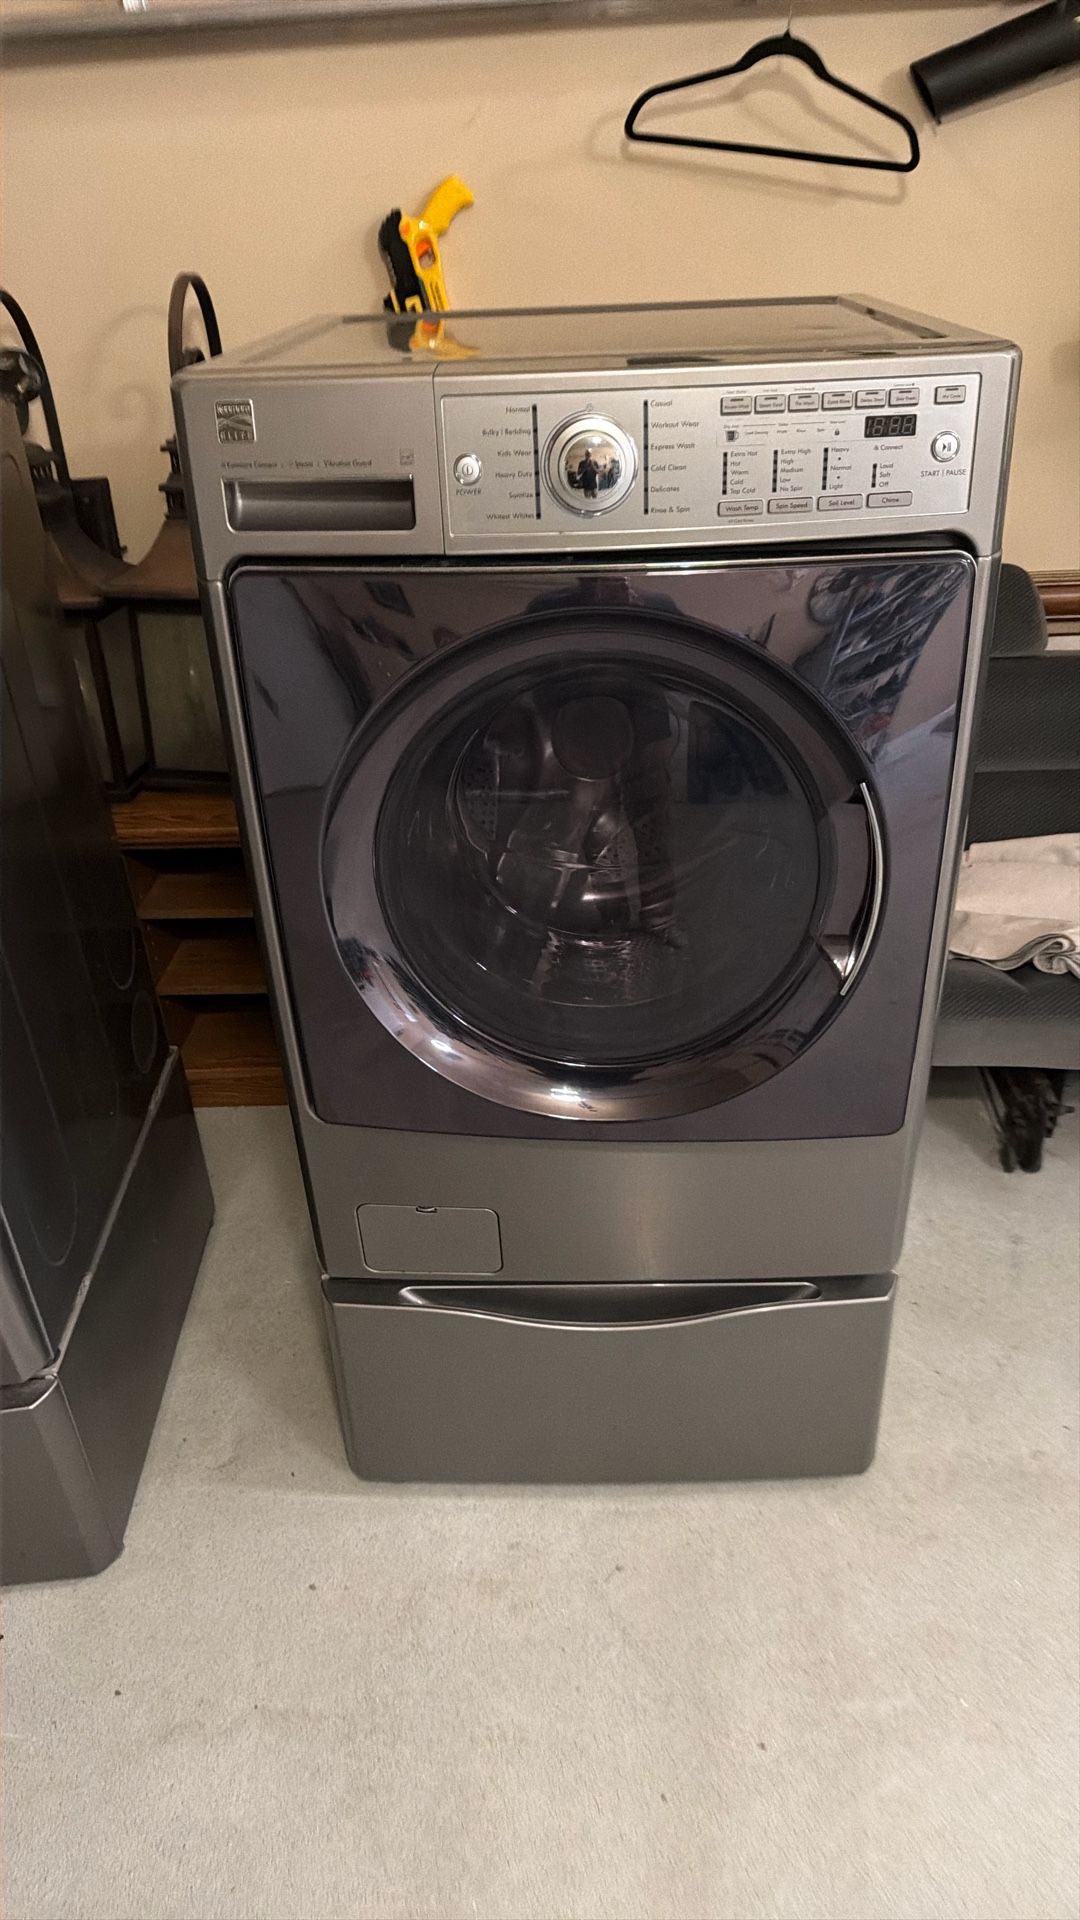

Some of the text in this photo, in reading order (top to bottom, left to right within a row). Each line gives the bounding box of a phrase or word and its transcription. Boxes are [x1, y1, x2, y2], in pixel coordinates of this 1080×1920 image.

[505, 406, 531, 414] Normal
[650, 443, 675, 451] Express
[831, 446, 849, 454] Heavy
[798, 448, 811, 456] High
[651, 464, 666, 472] Cold
[456, 488, 482, 496] POWER
[676, 506, 690, 514] Spin
[743, 504, 759, 512] Temp
